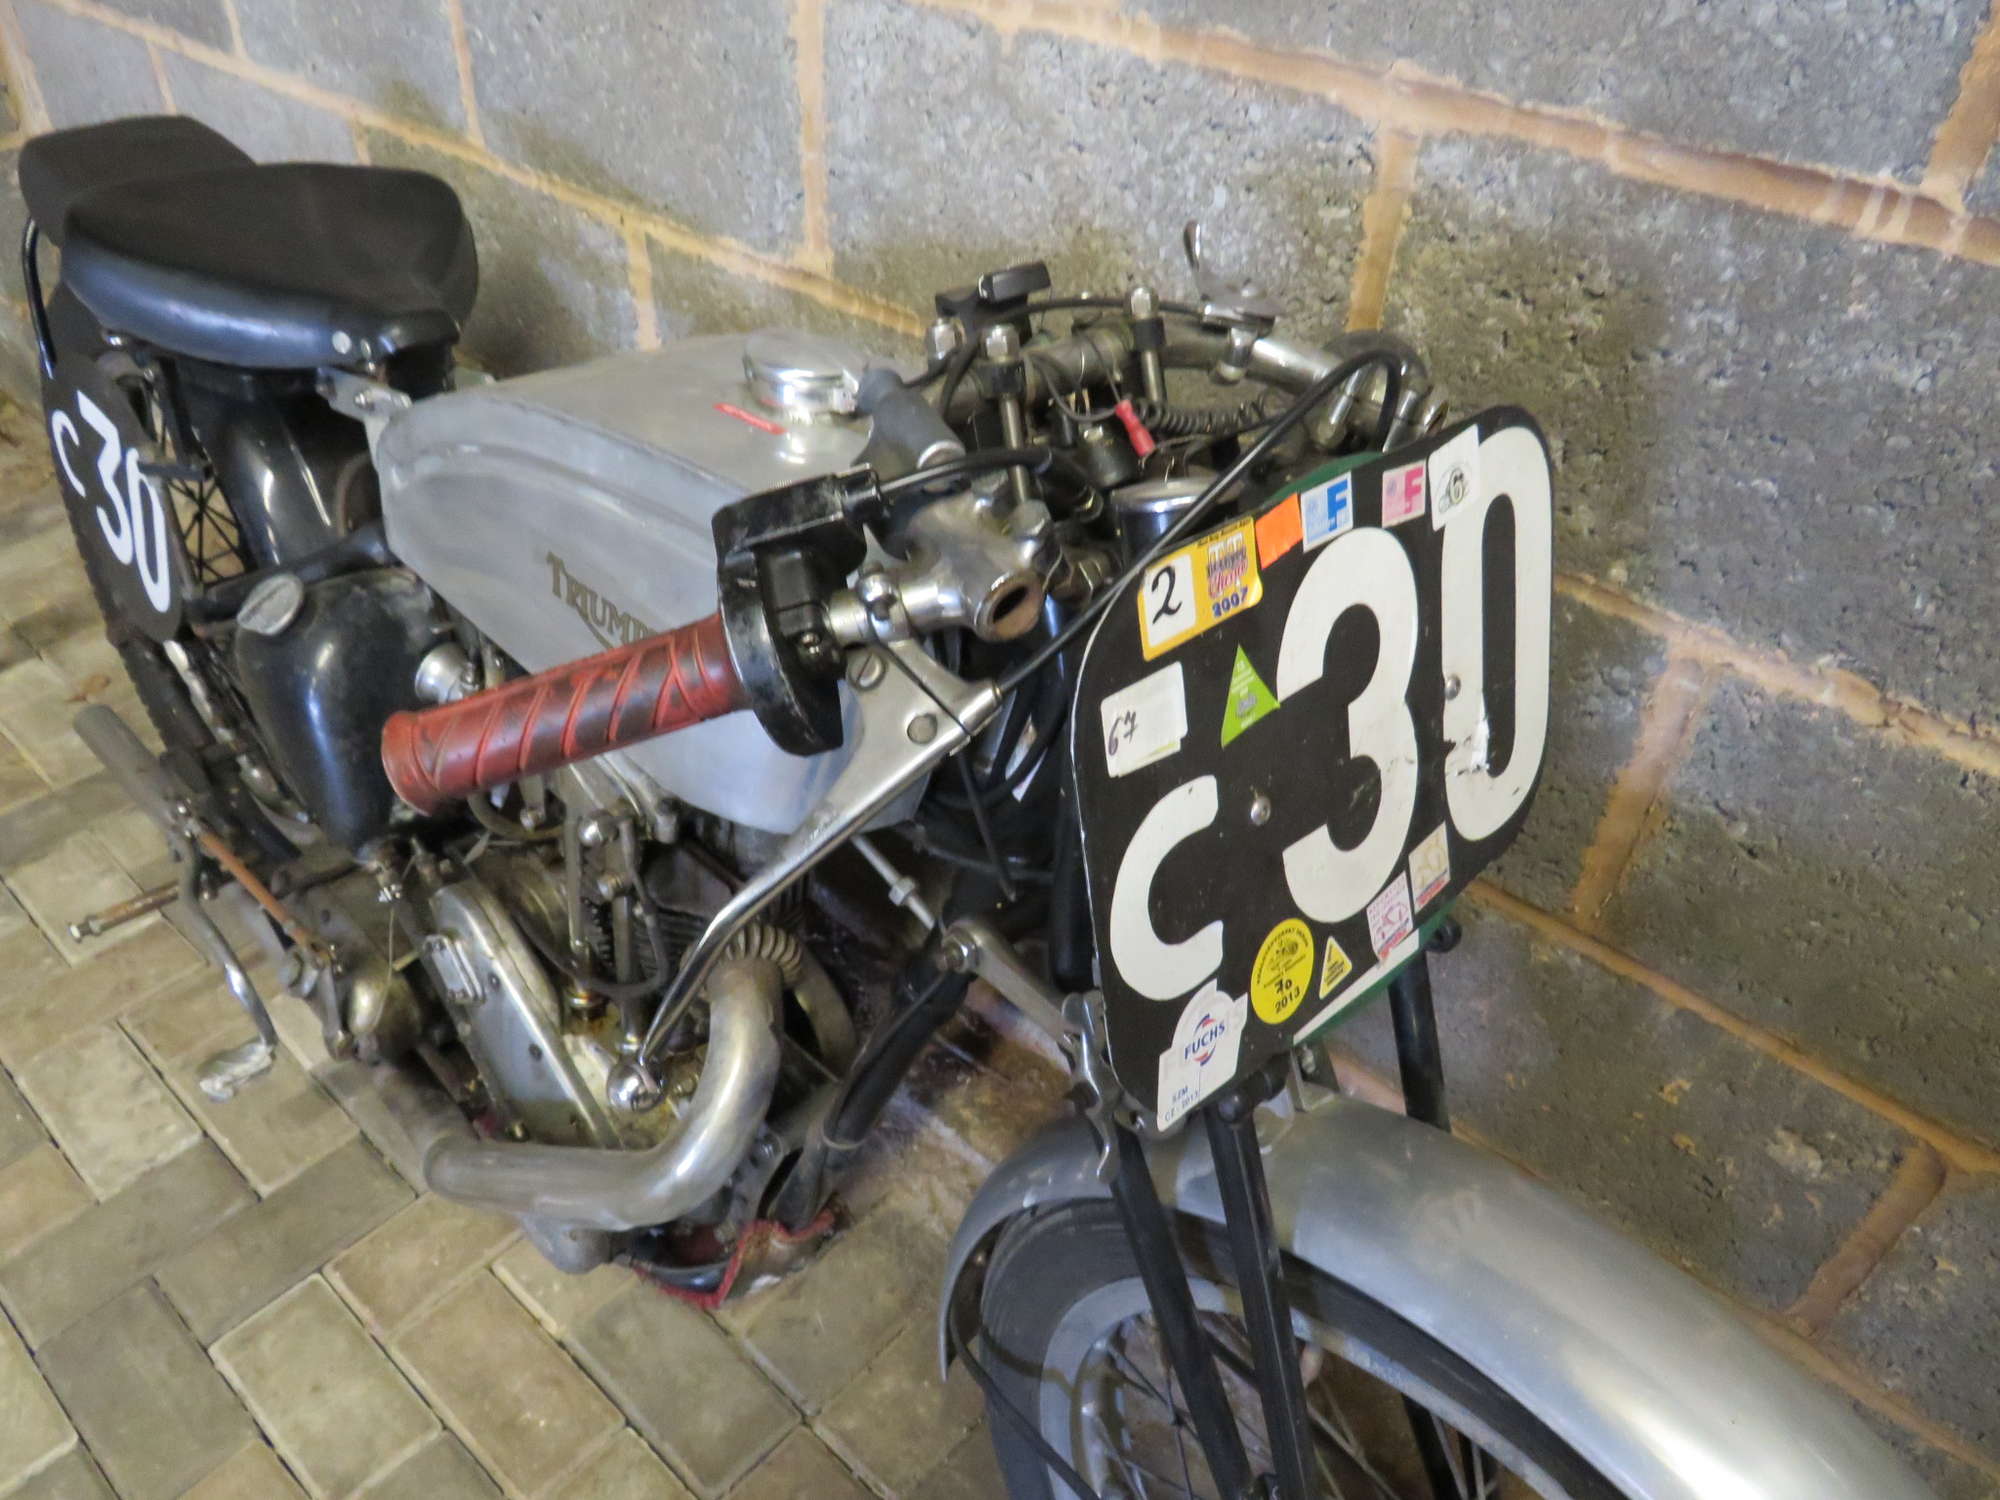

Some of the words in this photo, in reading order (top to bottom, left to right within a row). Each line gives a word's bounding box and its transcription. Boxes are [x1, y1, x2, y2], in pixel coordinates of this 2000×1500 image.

[546, 552, 658, 645] TRIUMP
[1151, 565, 1183, 625] 2
[1212, 586, 1248, 618] 2007
[1184, 1022, 1226, 1061] FUCHS
